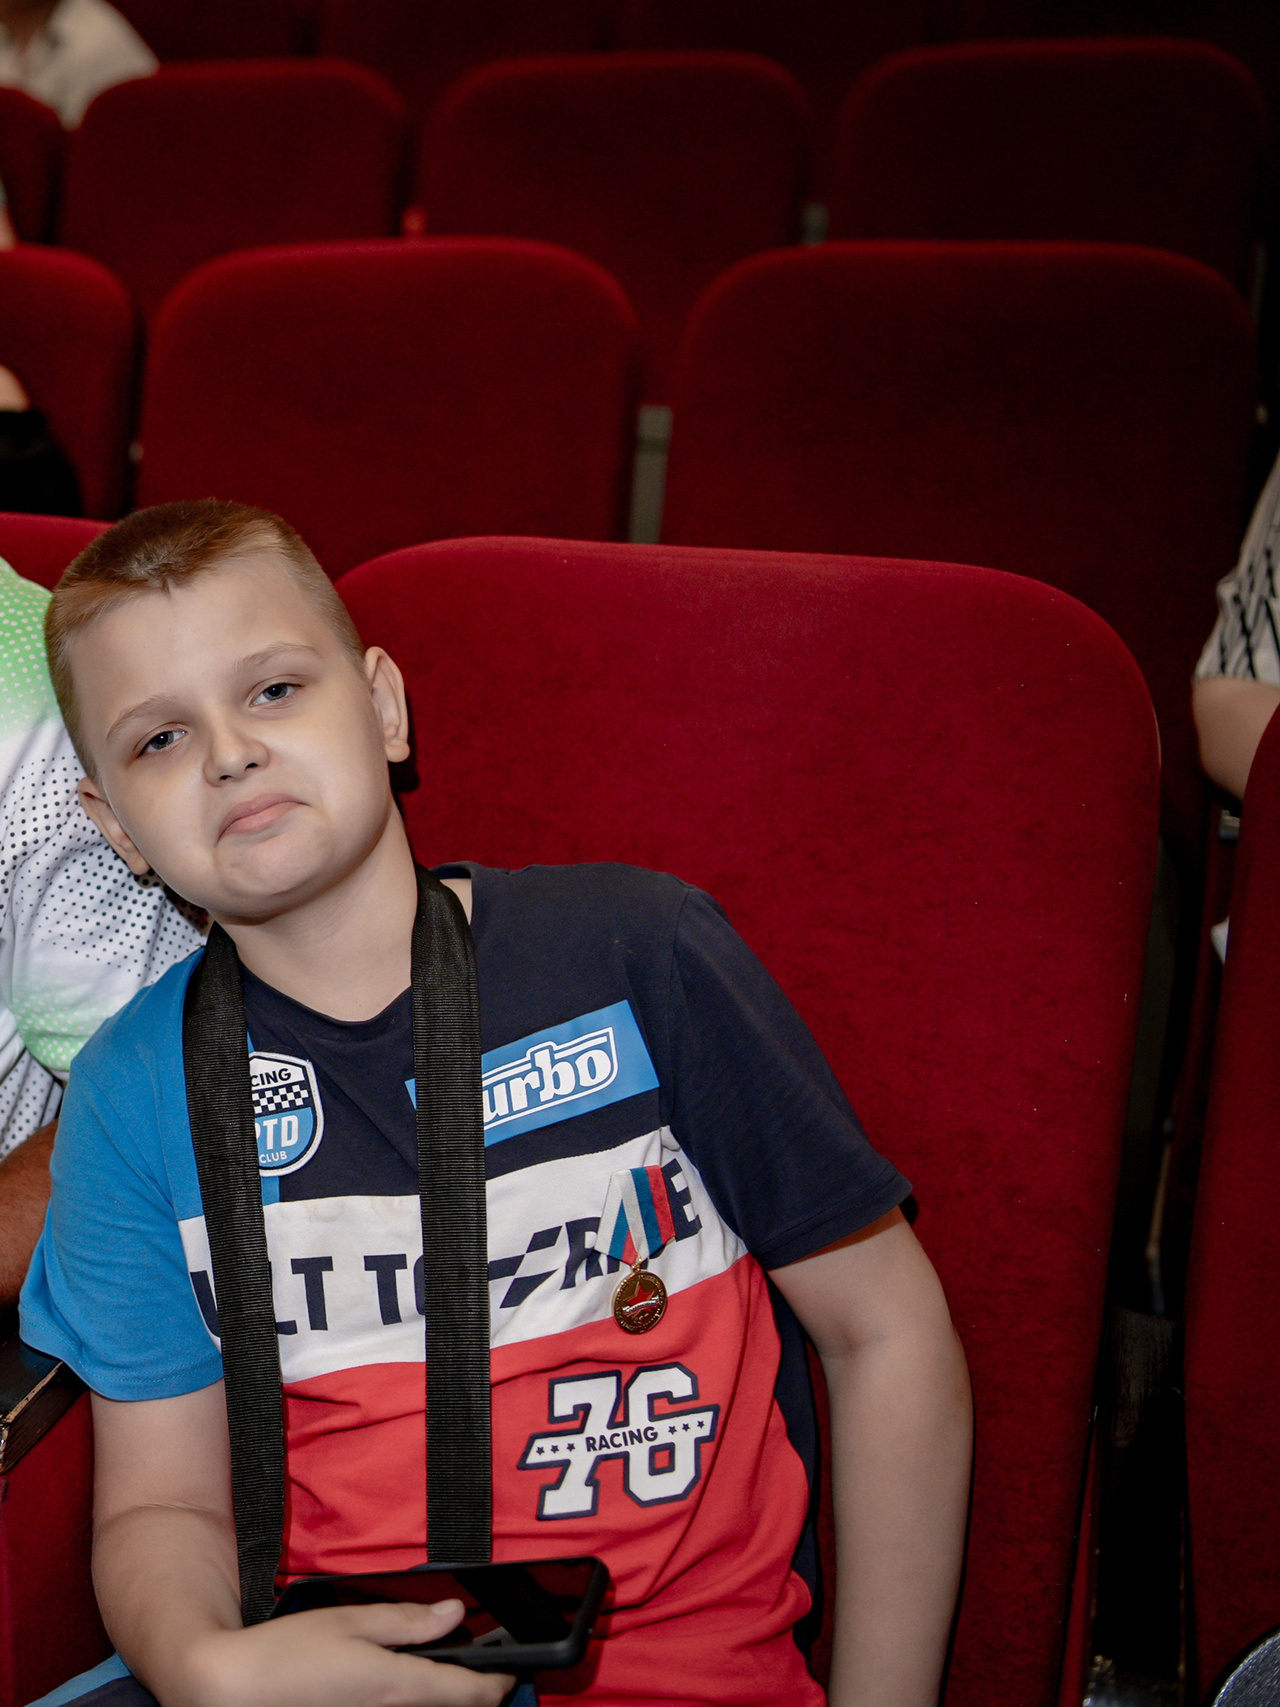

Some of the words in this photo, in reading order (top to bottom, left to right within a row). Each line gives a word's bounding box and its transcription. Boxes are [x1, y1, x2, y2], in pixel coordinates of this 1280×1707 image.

[251, 1068, 291, 1087] CING
[483, 1045, 612, 1123] urbo
[255, 1115, 299, 1150] TD
[260, 1150, 288, 1164] CLUB
[559, 1157, 703, 1290] RE
[518, 1362, 720, 1521] 76
[585, 1425, 659, 1452] RACING
